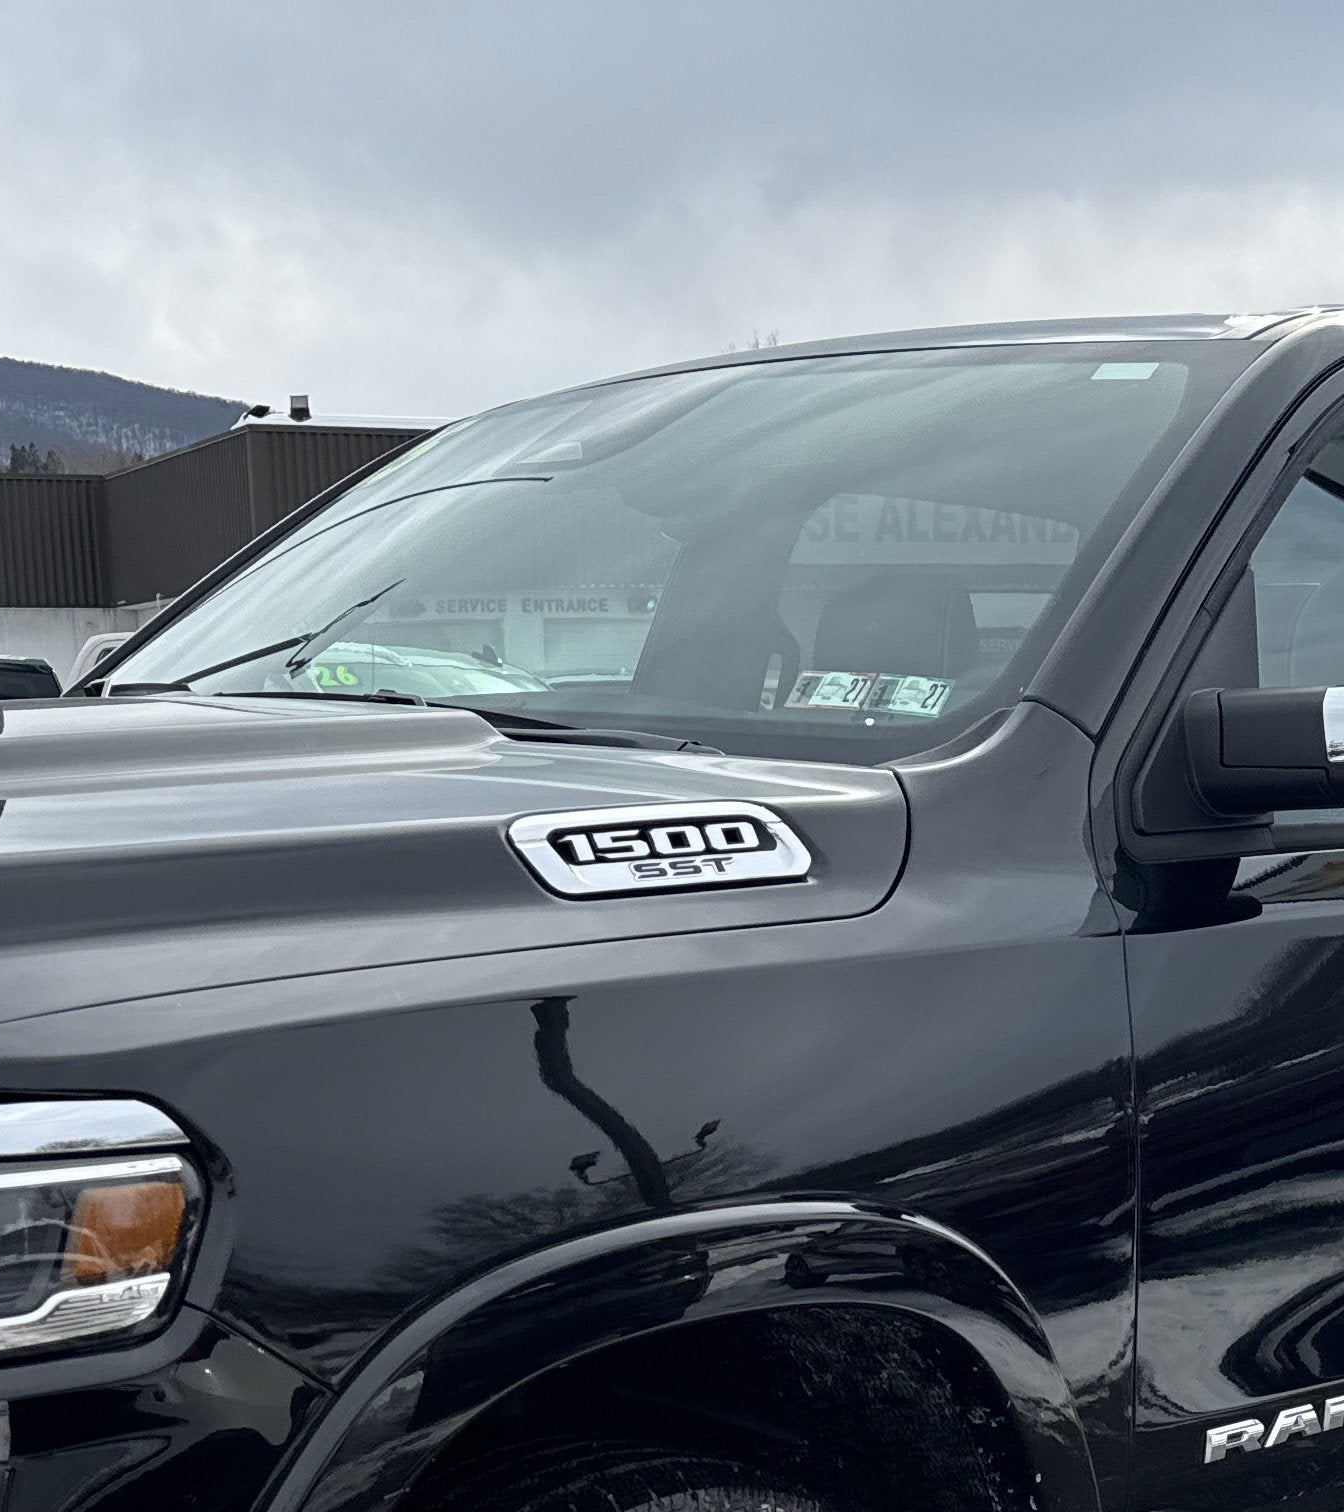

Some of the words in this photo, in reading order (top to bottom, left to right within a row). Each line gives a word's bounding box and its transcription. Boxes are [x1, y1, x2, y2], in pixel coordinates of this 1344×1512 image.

[435, 598, 507, 614] SERVICE
[522, 598, 609, 613] ENTRANCE
[315, 666, 358, 687] 26
[842, 678, 868, 703] 27
[920, 683, 948, 711] 27
[557, 821, 760, 863] 1500
[631, 856, 734, 880] SST
